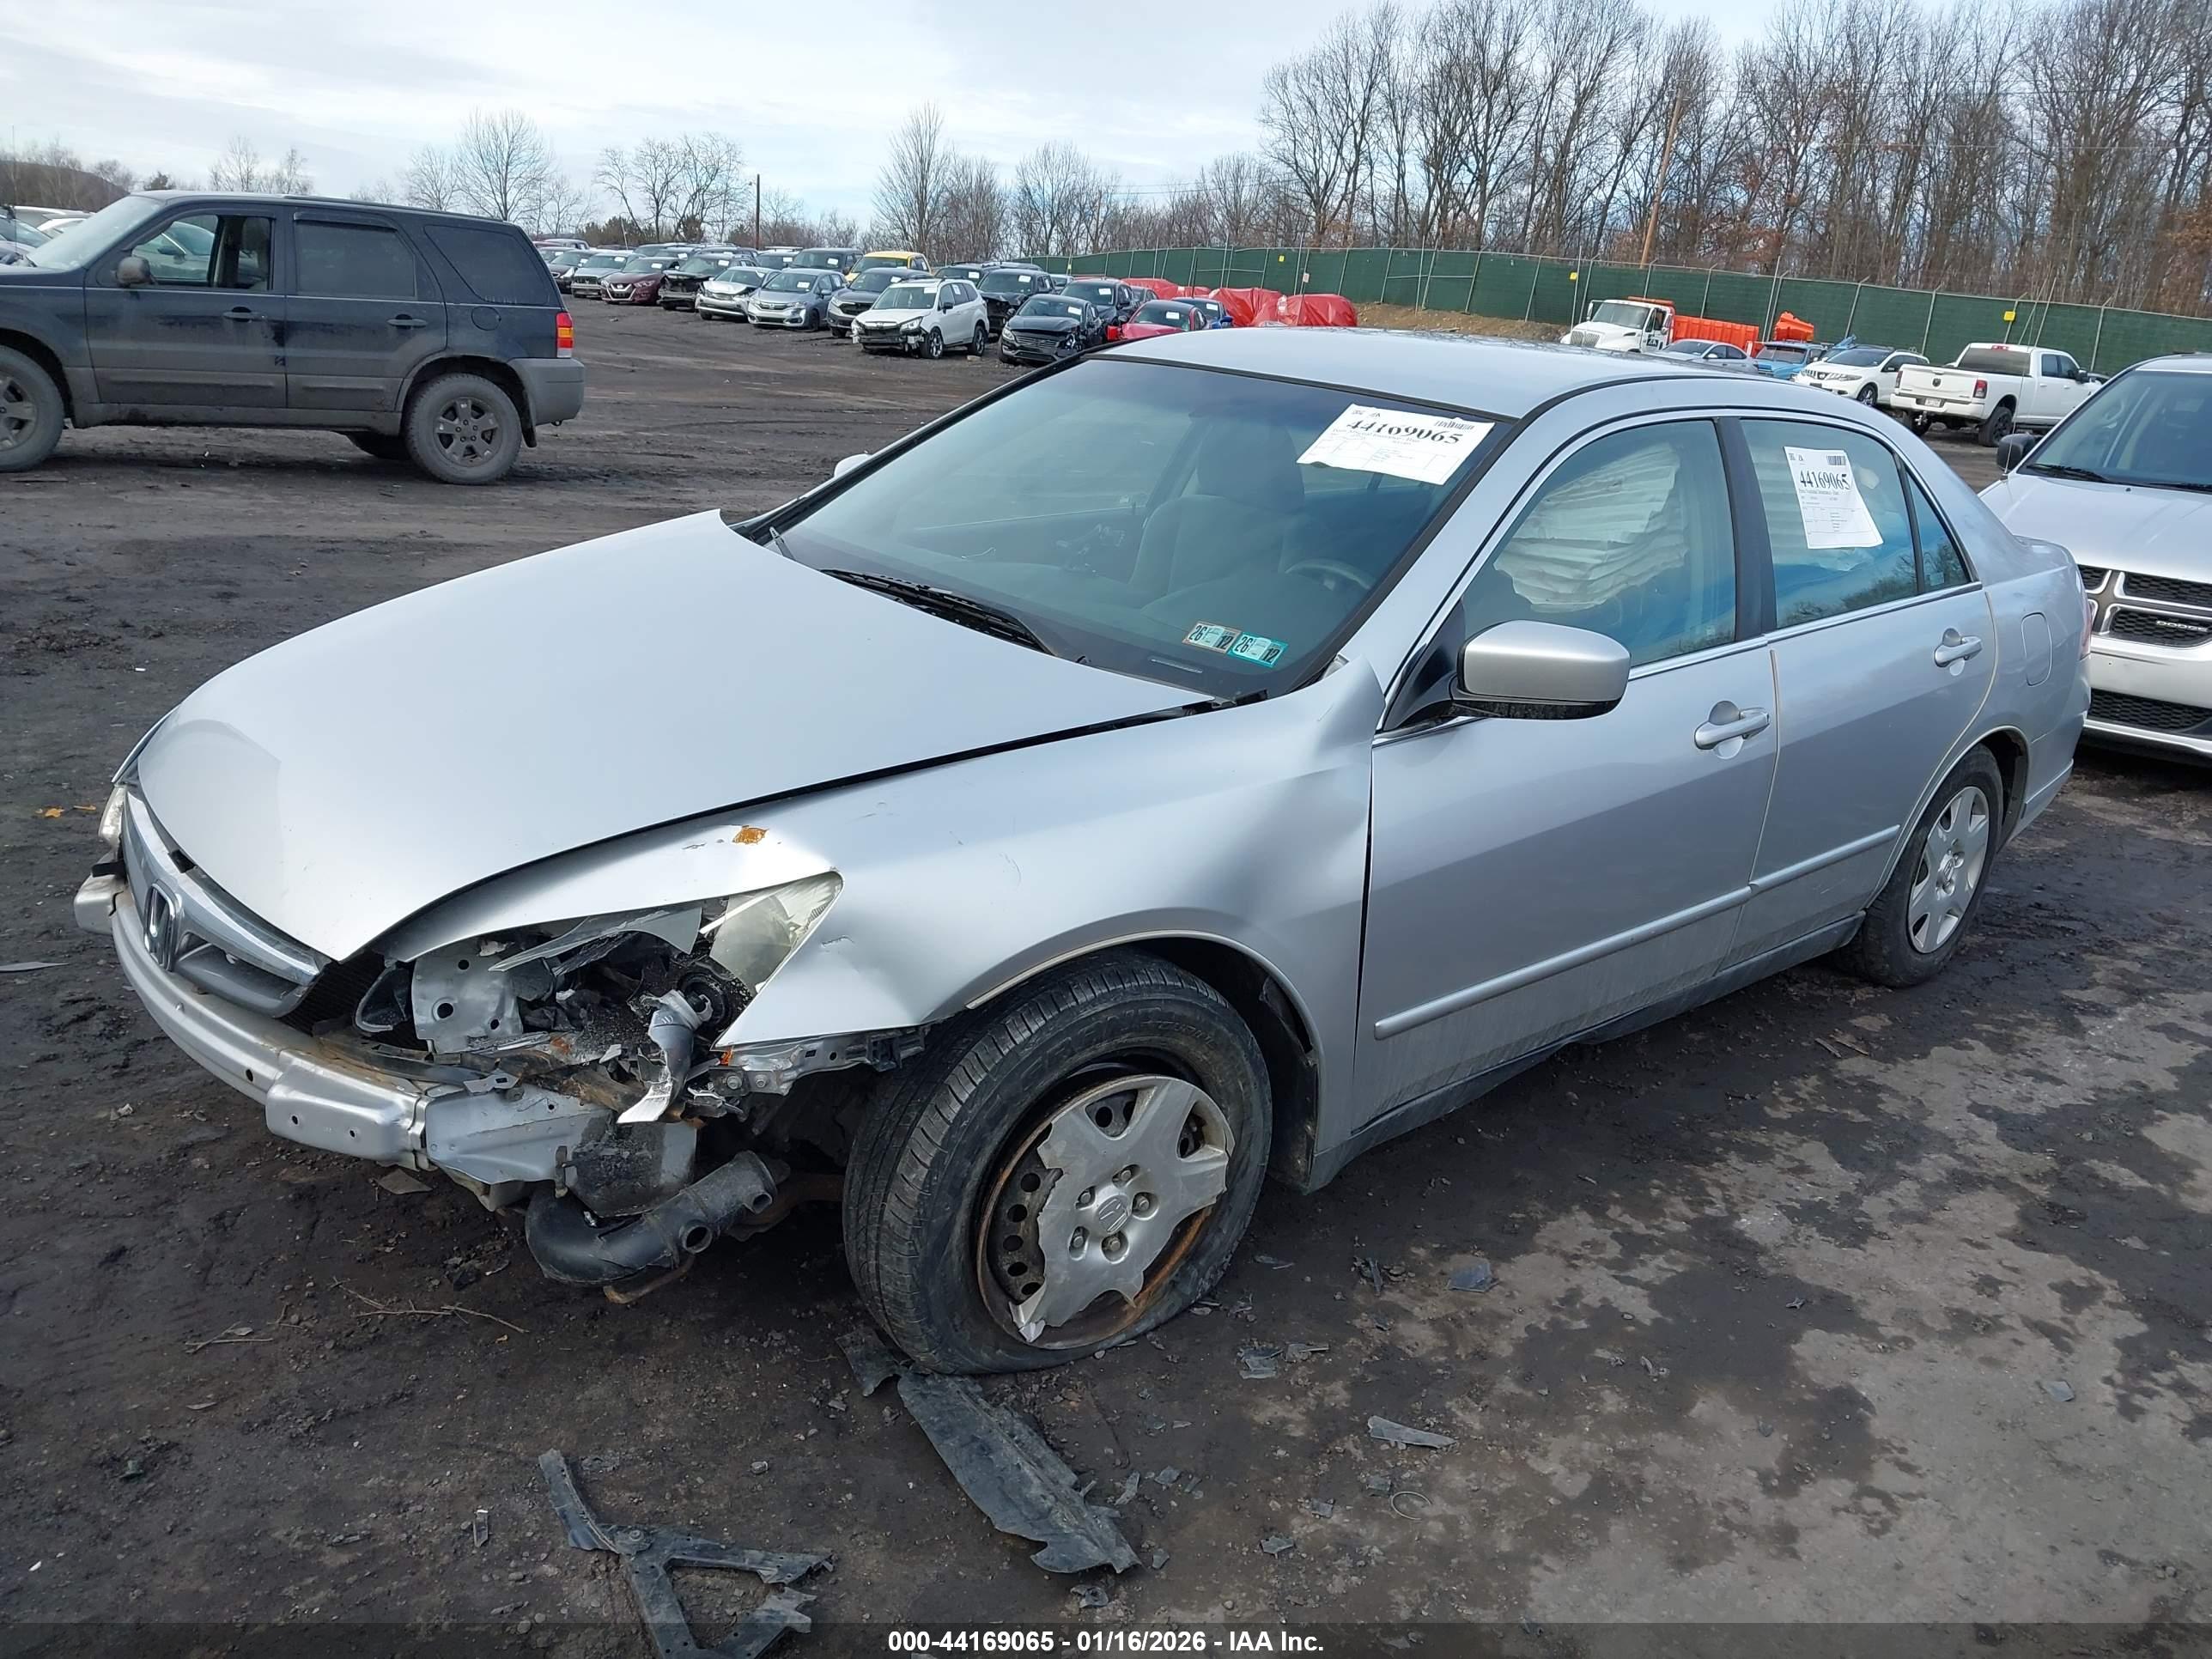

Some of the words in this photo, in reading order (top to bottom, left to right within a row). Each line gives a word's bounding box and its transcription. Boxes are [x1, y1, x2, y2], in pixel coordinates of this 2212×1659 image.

[1799, 470, 1851, 490] 44169065
[1189, 625, 1206, 641] 26
[1217, 635, 1234, 650] 12
[1236, 636, 1255, 653] 26
[1262, 648, 1280, 663] 12
